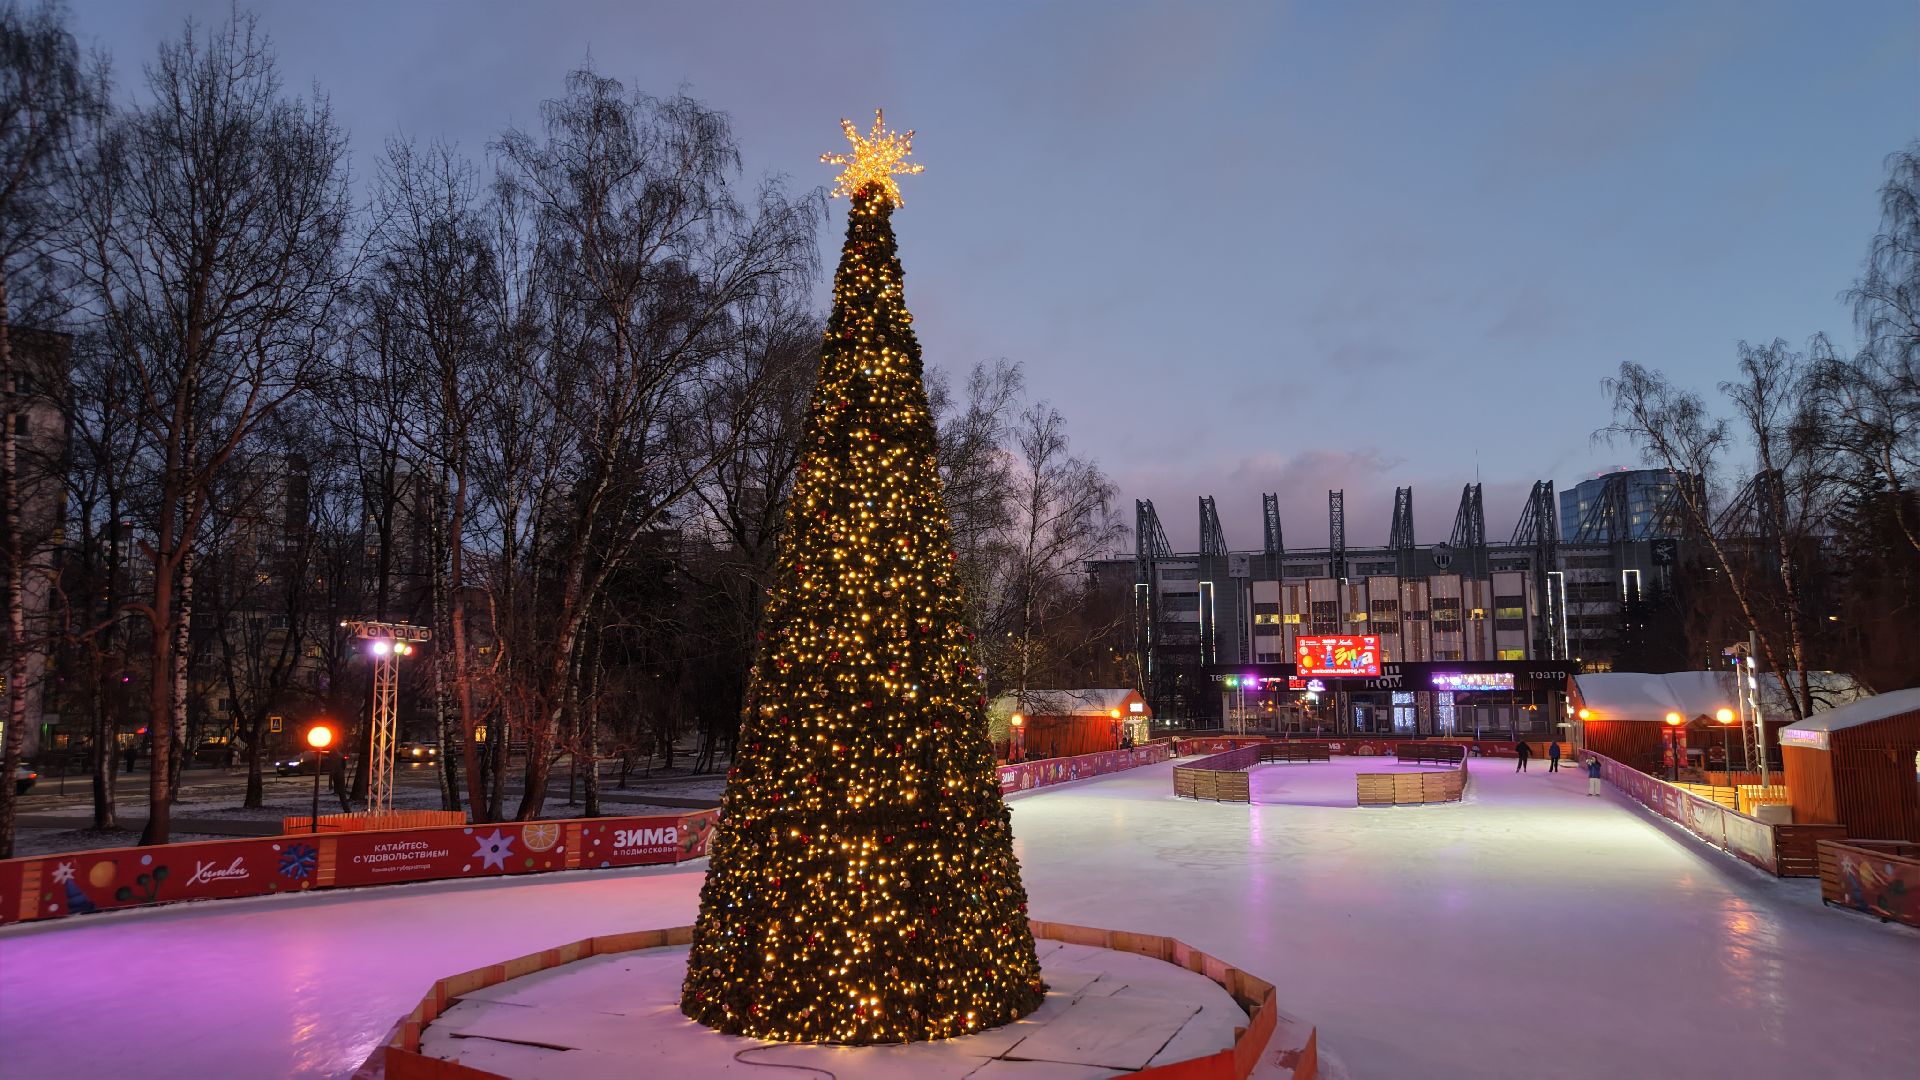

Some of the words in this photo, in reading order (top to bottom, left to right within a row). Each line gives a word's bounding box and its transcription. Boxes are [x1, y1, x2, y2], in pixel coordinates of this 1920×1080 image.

[374, 841, 429, 853] КАТАЙТЕСЬ
[353, 855, 361, 863] С
[363, 849, 449, 863] УДОВОЛЬСТВИЕМ!
[186, 856, 250, 887] Химки
